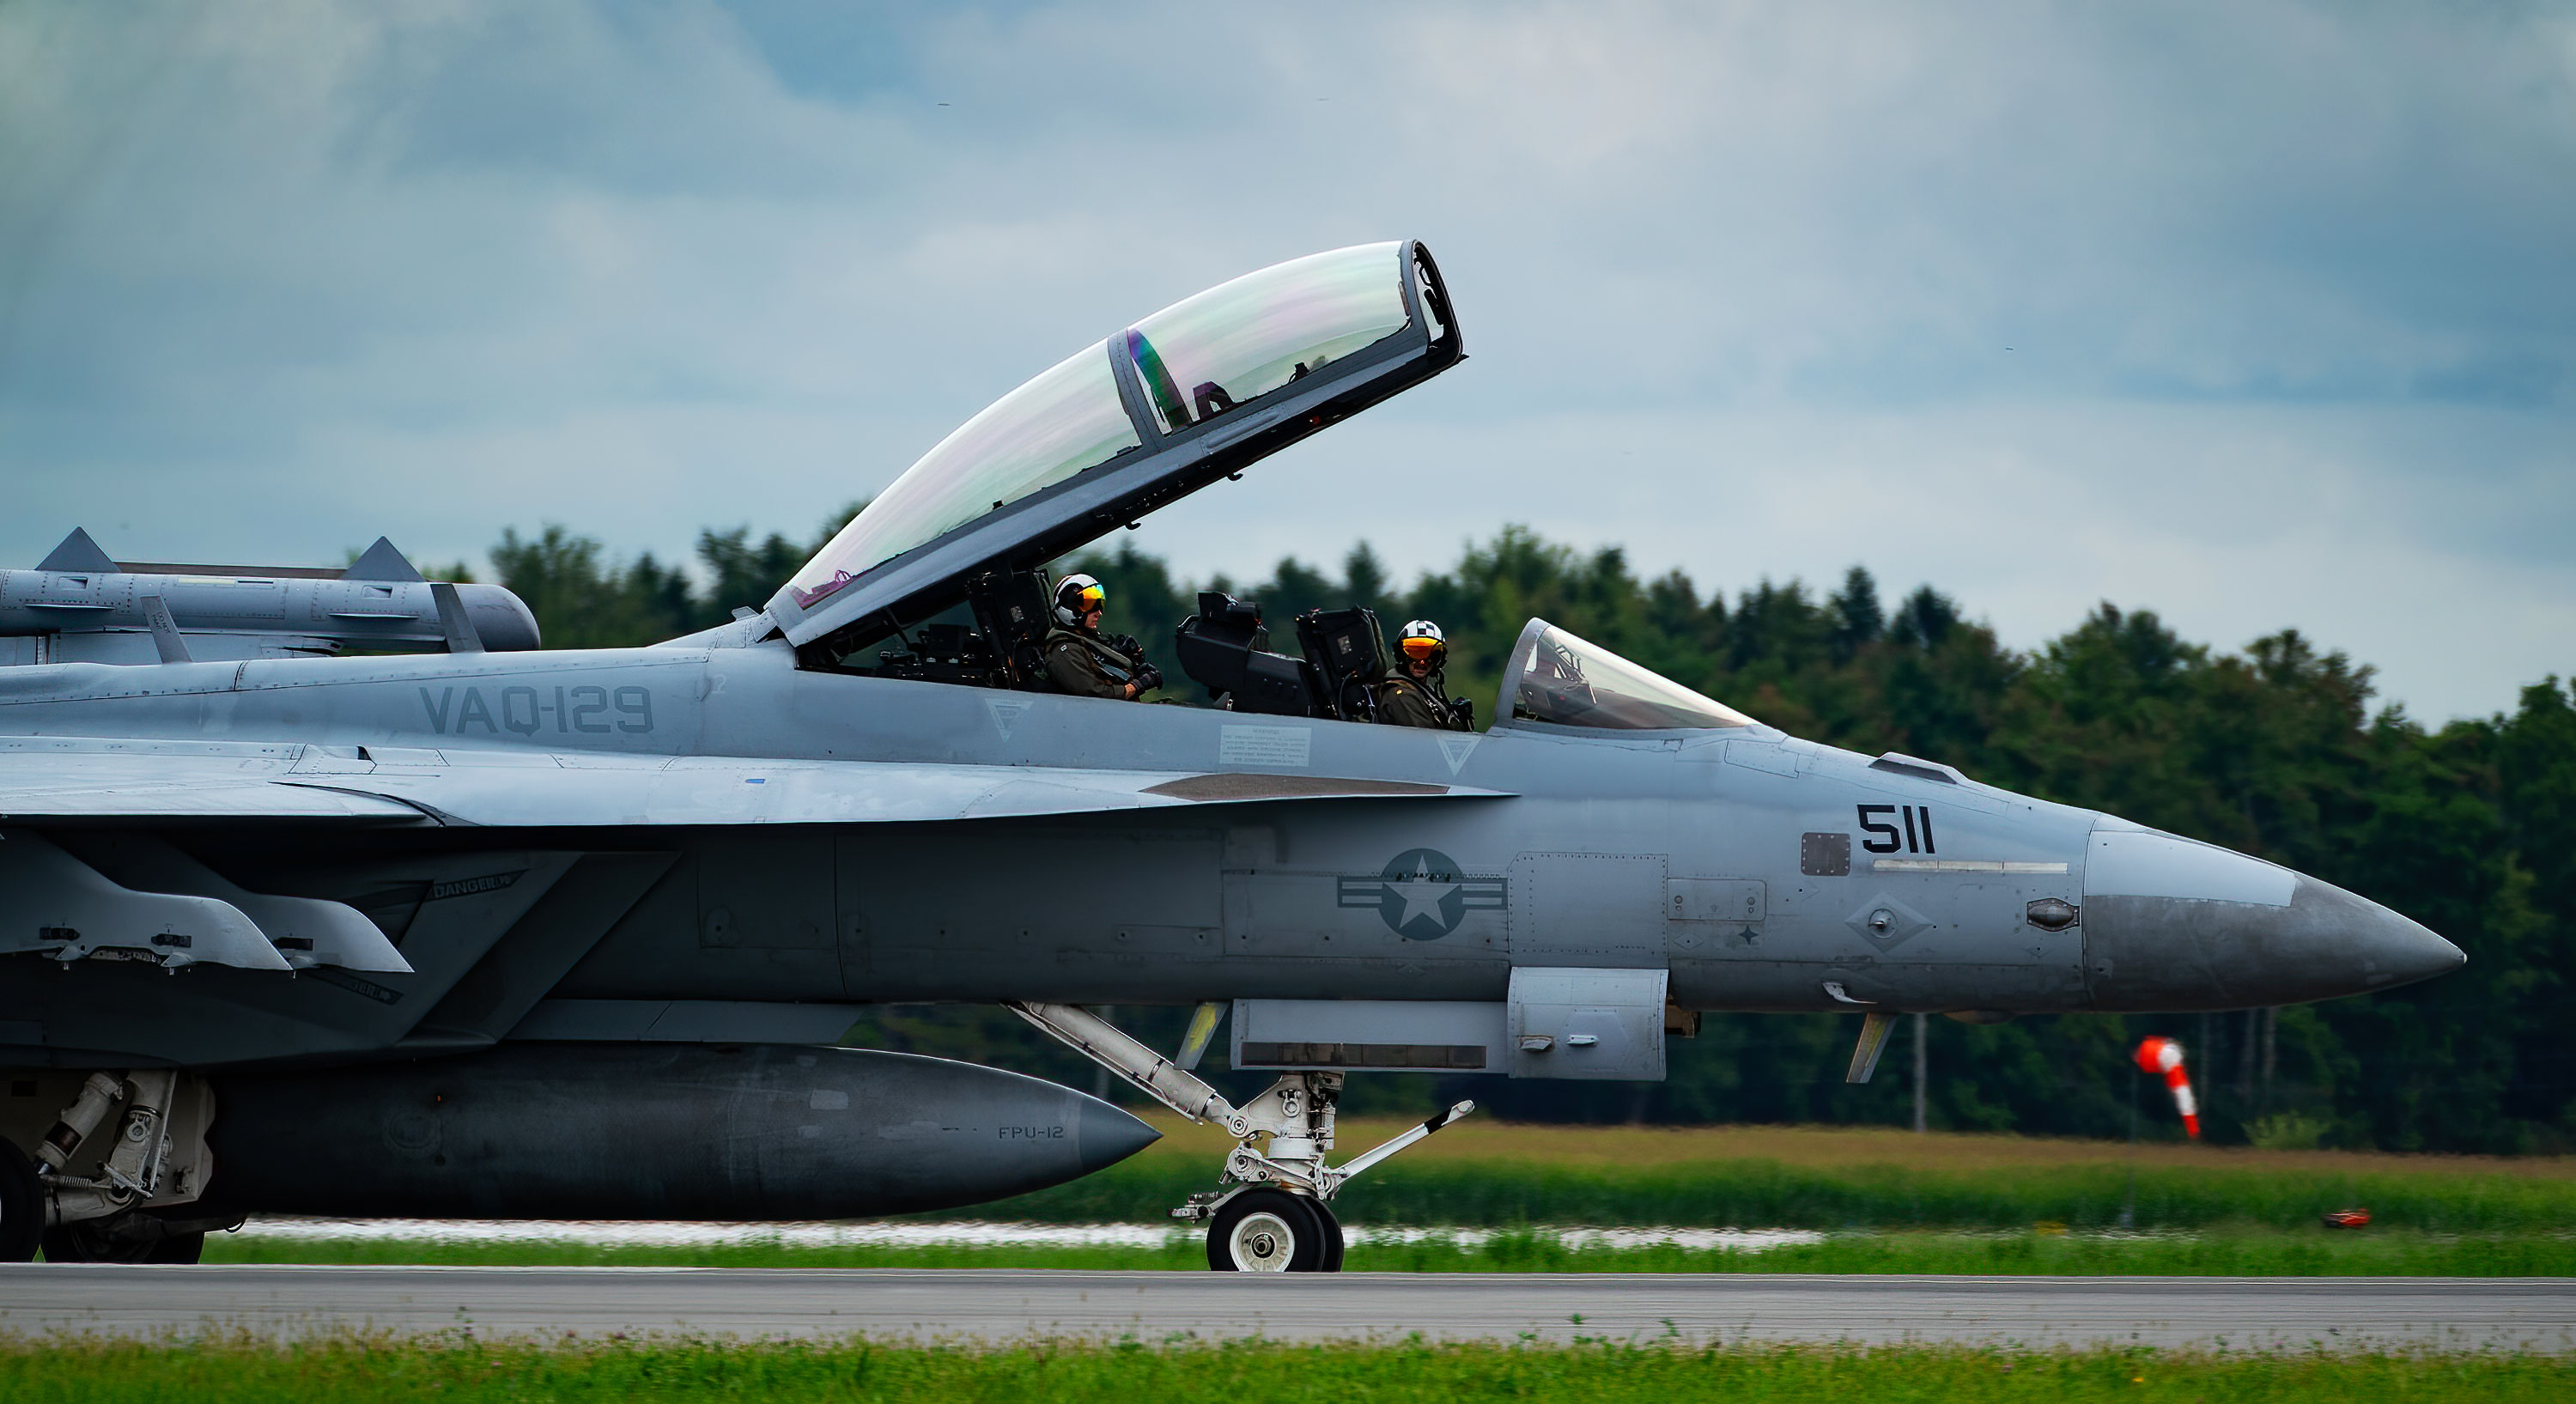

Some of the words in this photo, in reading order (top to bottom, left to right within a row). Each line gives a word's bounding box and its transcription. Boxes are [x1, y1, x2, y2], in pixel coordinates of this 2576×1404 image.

[419, 686, 653, 737] VAQ-129
[1856, 804, 1935, 854] 511
[999, 1126, 1064, 1139] FPU-12
